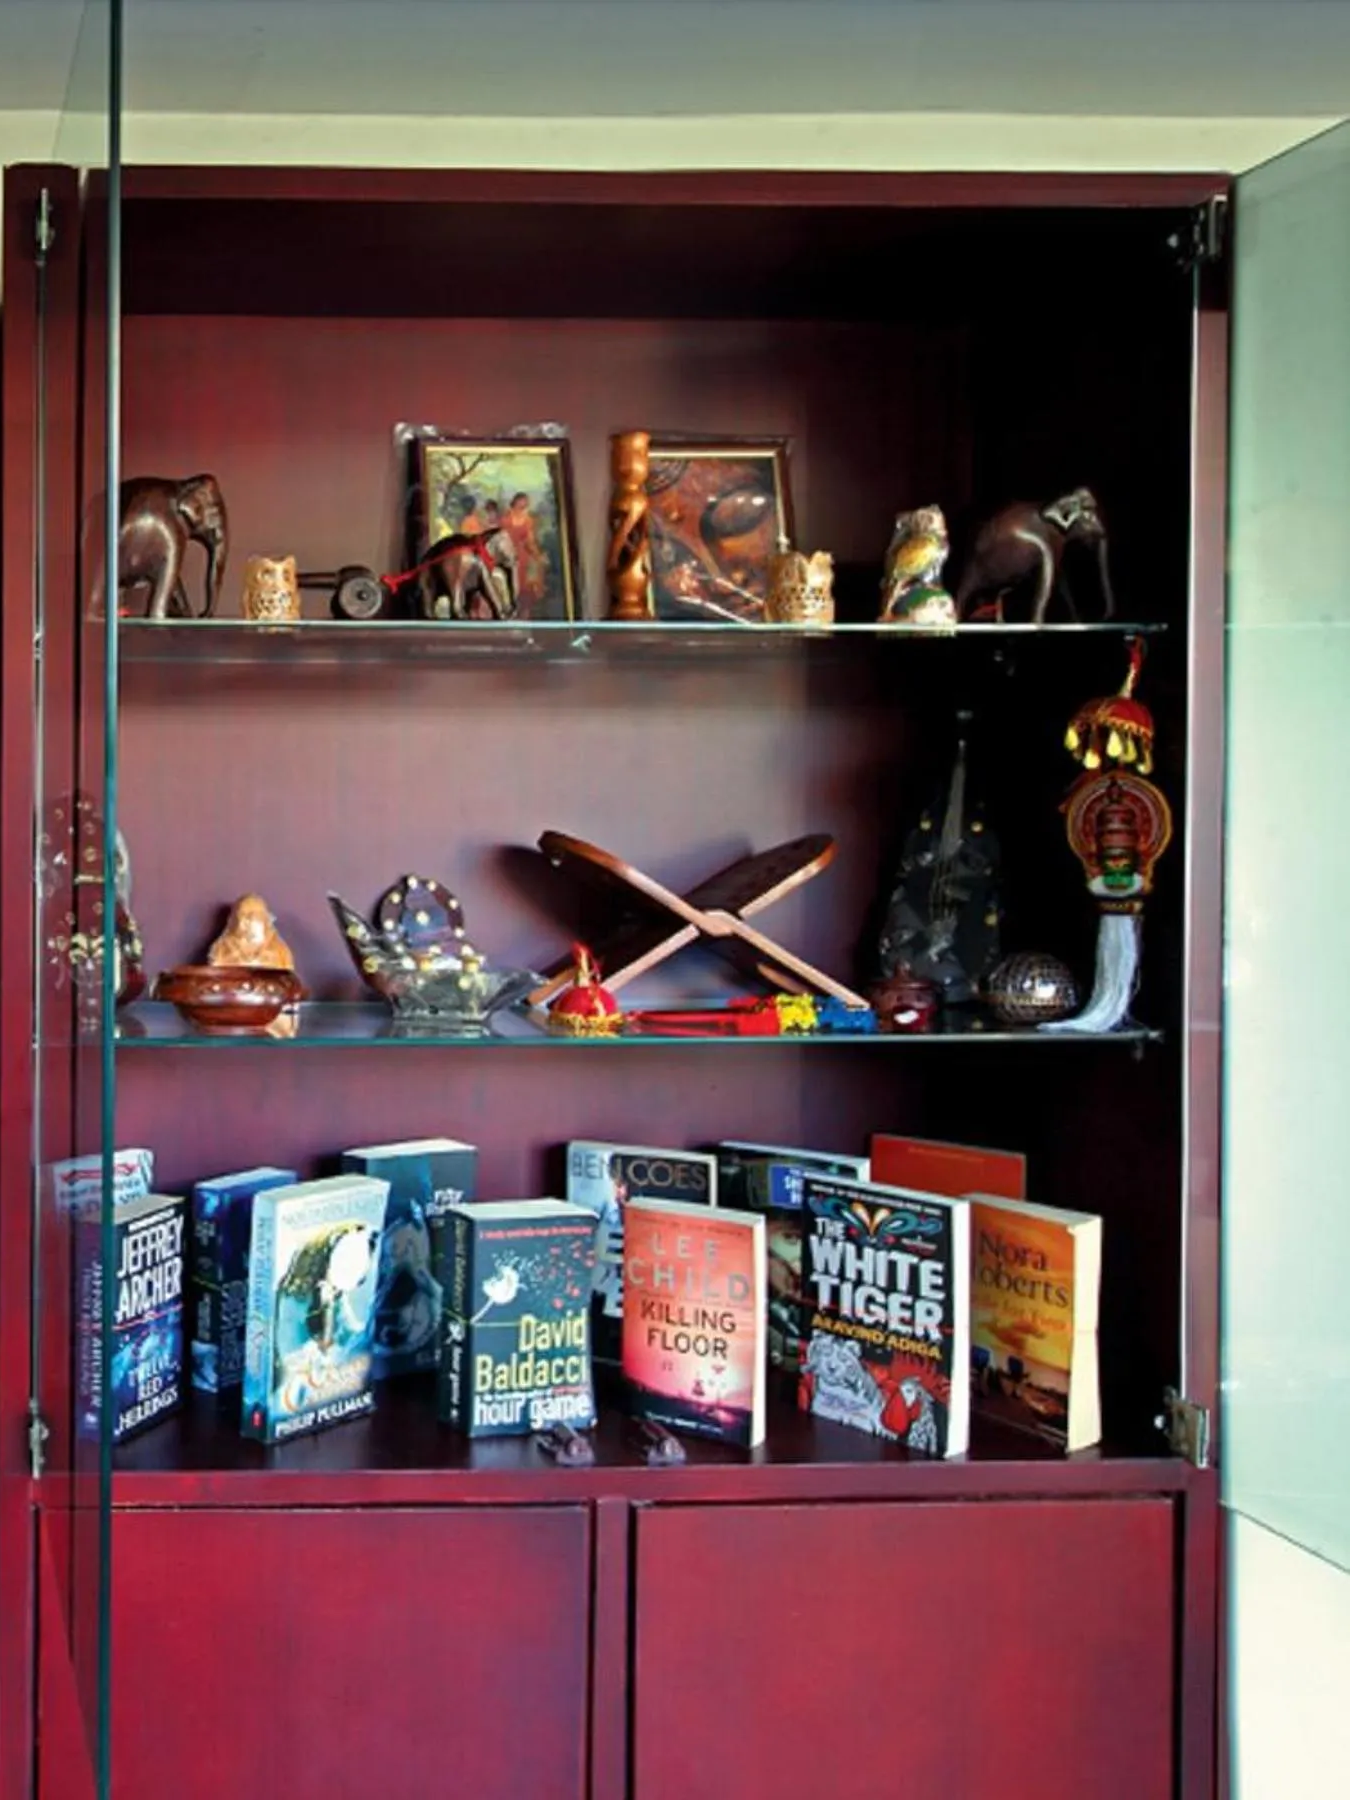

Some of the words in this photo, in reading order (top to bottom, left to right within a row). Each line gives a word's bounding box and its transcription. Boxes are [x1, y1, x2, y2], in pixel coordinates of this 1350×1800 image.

[571, 1151, 623, 1179] BEN
[627, 1159, 707, 1192] COES
[116, 1214, 185, 1279] JEFFREY
[651, 1231, 721, 1266] LEE
[814, 1217, 847, 1241] THE
[979, 1229, 1048, 1272] Nora
[626, 1256, 751, 1304] CHILD
[809, 1233, 946, 1301] WHITE
[979, 1263, 1069, 1309] oberts
[115, 1257, 183, 1324] ARCHER
[809, 1271, 944, 1343] TIGER
[518, 1307, 588, 1353] David
[639, 1299, 737, 1334] KILLING
[810, 1313, 886, 1346] ARAVIND
[886, 1333, 943, 1361] ADIGA
[646, 1327, 729, 1361] FLOOR
[474, 1351, 588, 1393] Baldacci
[473, 1394, 526, 1426] hour
[529, 1393, 591, 1430] game
